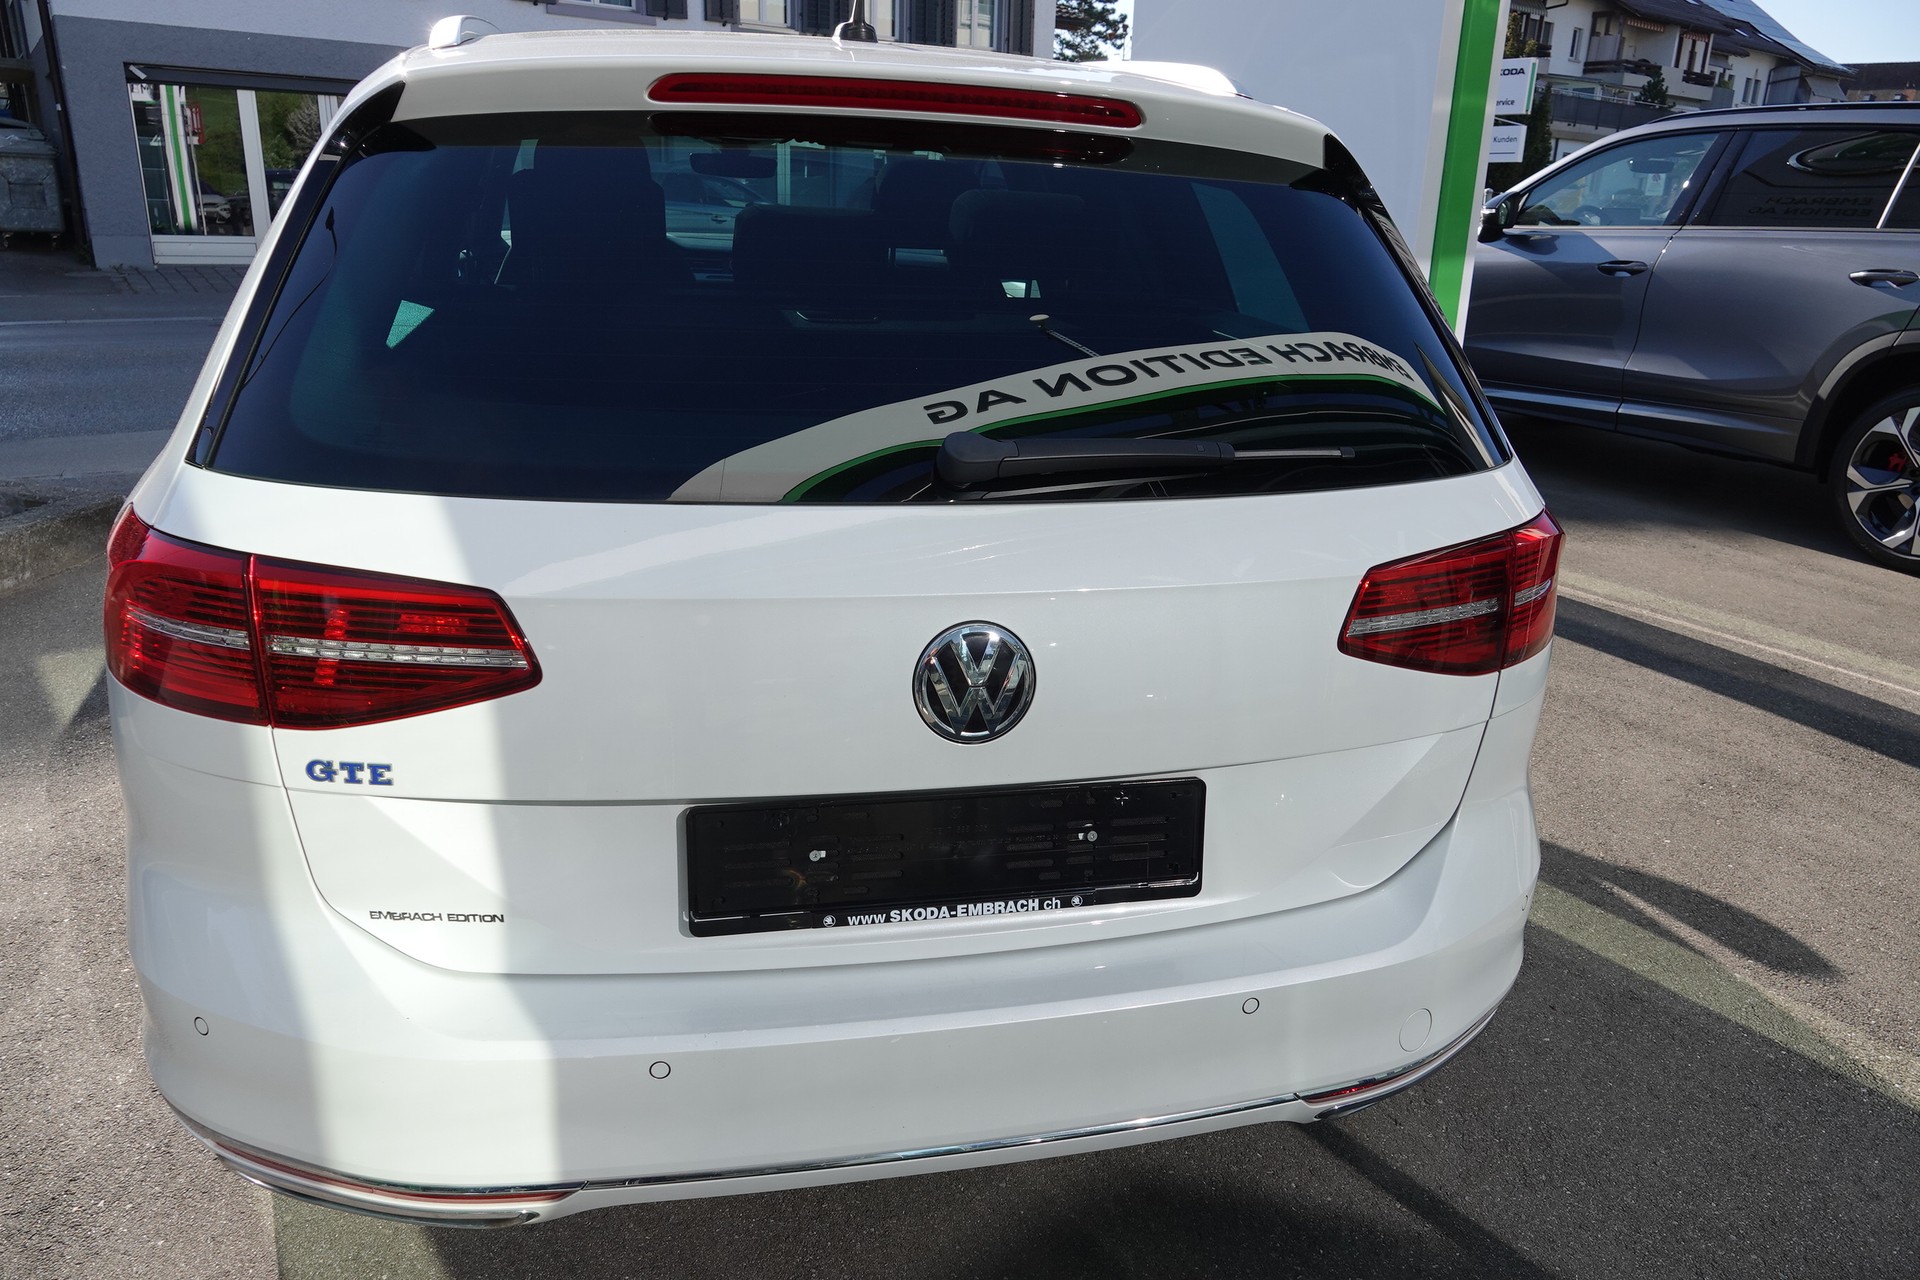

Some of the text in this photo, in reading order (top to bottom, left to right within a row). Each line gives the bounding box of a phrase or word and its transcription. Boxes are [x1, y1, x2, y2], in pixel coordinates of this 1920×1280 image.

[915, 623, 1033, 742] VW
[305, 759, 394, 786] GTE
[369, 910, 505, 923] EMBRACH EDITION
[847, 897, 1061, 926] www SKODA-EMBRACH ch
